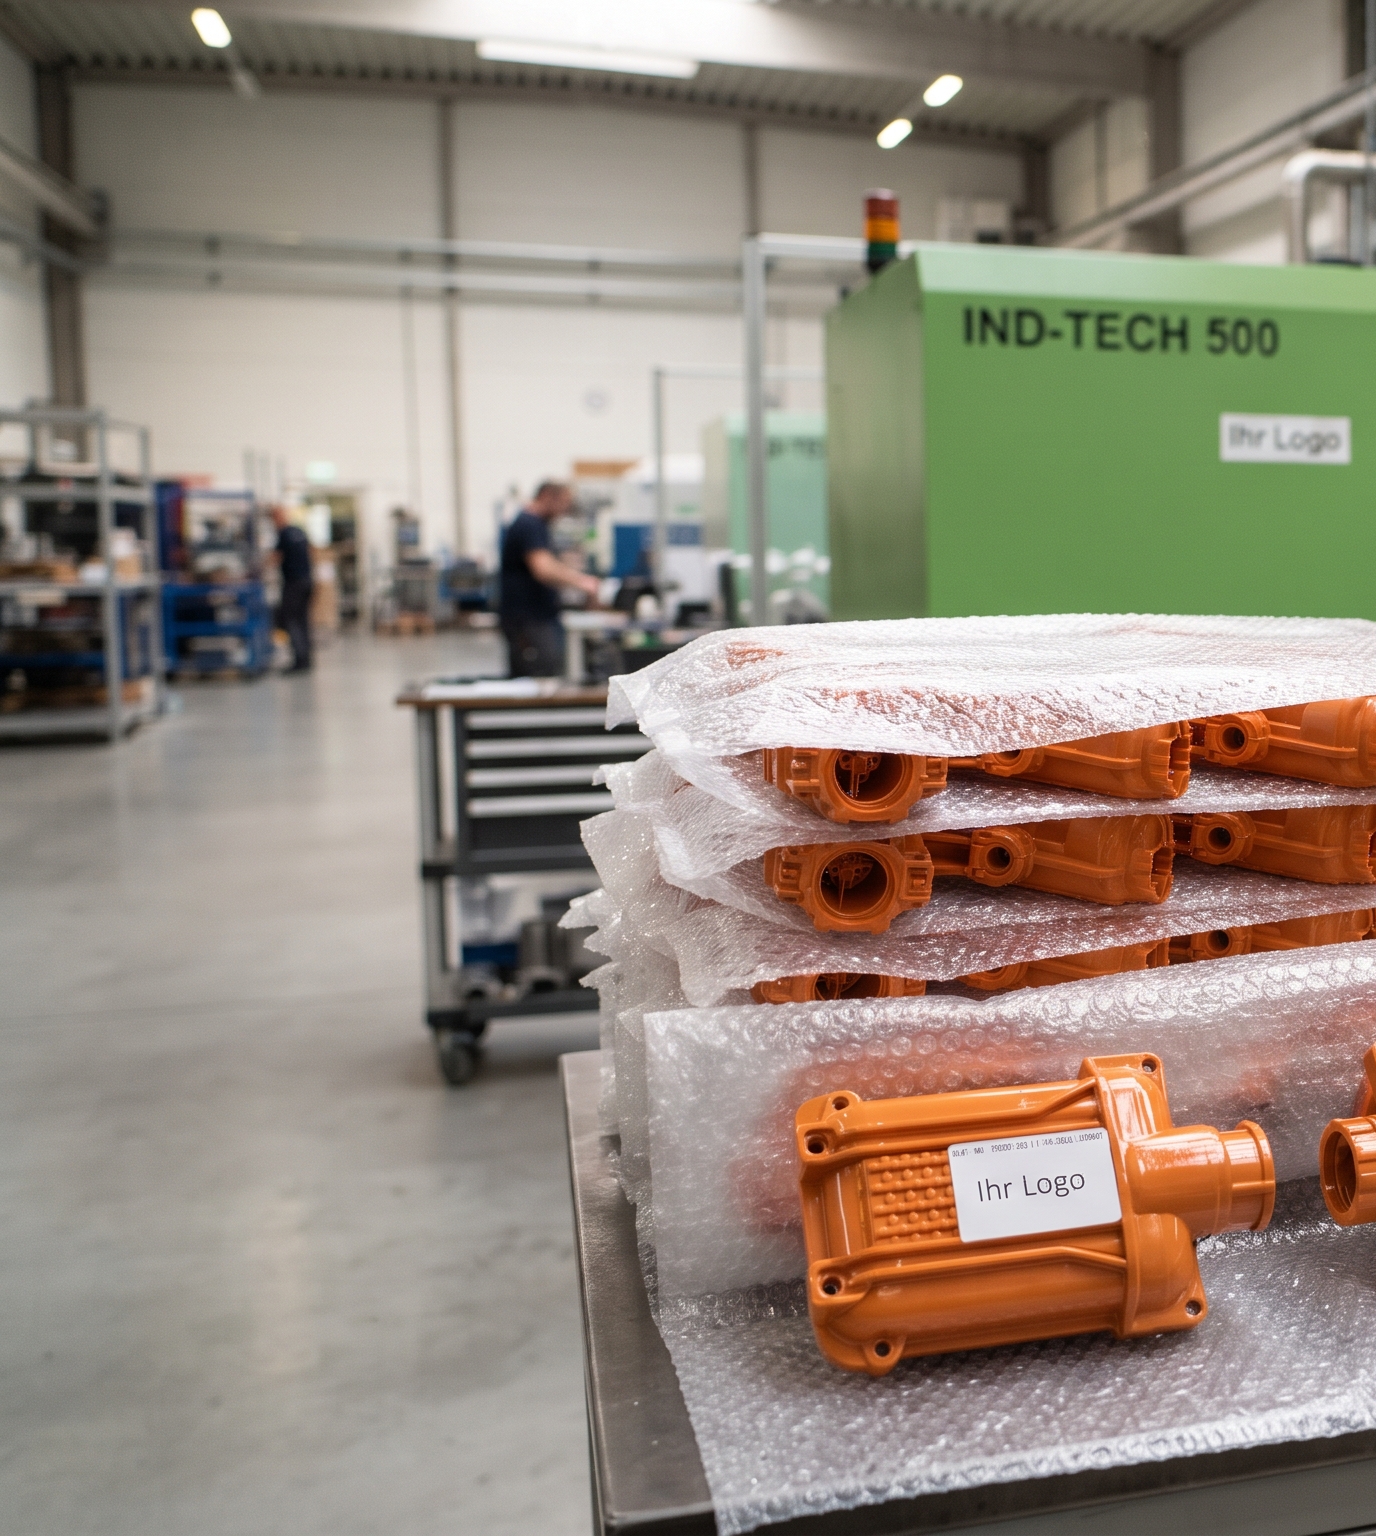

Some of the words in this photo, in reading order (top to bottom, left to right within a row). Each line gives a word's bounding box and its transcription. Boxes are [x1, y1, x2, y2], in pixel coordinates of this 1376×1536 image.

[964, 306, 1190, 352] IND-TECH
[1206, 316, 1280, 358] 500
[1228, 423, 1266, 449] Ihr
[1273, 423, 1342, 457] Logo
[978, 1178, 1012, 1202] Ihr
[1022, 1172, 1086, 1198] Logo
